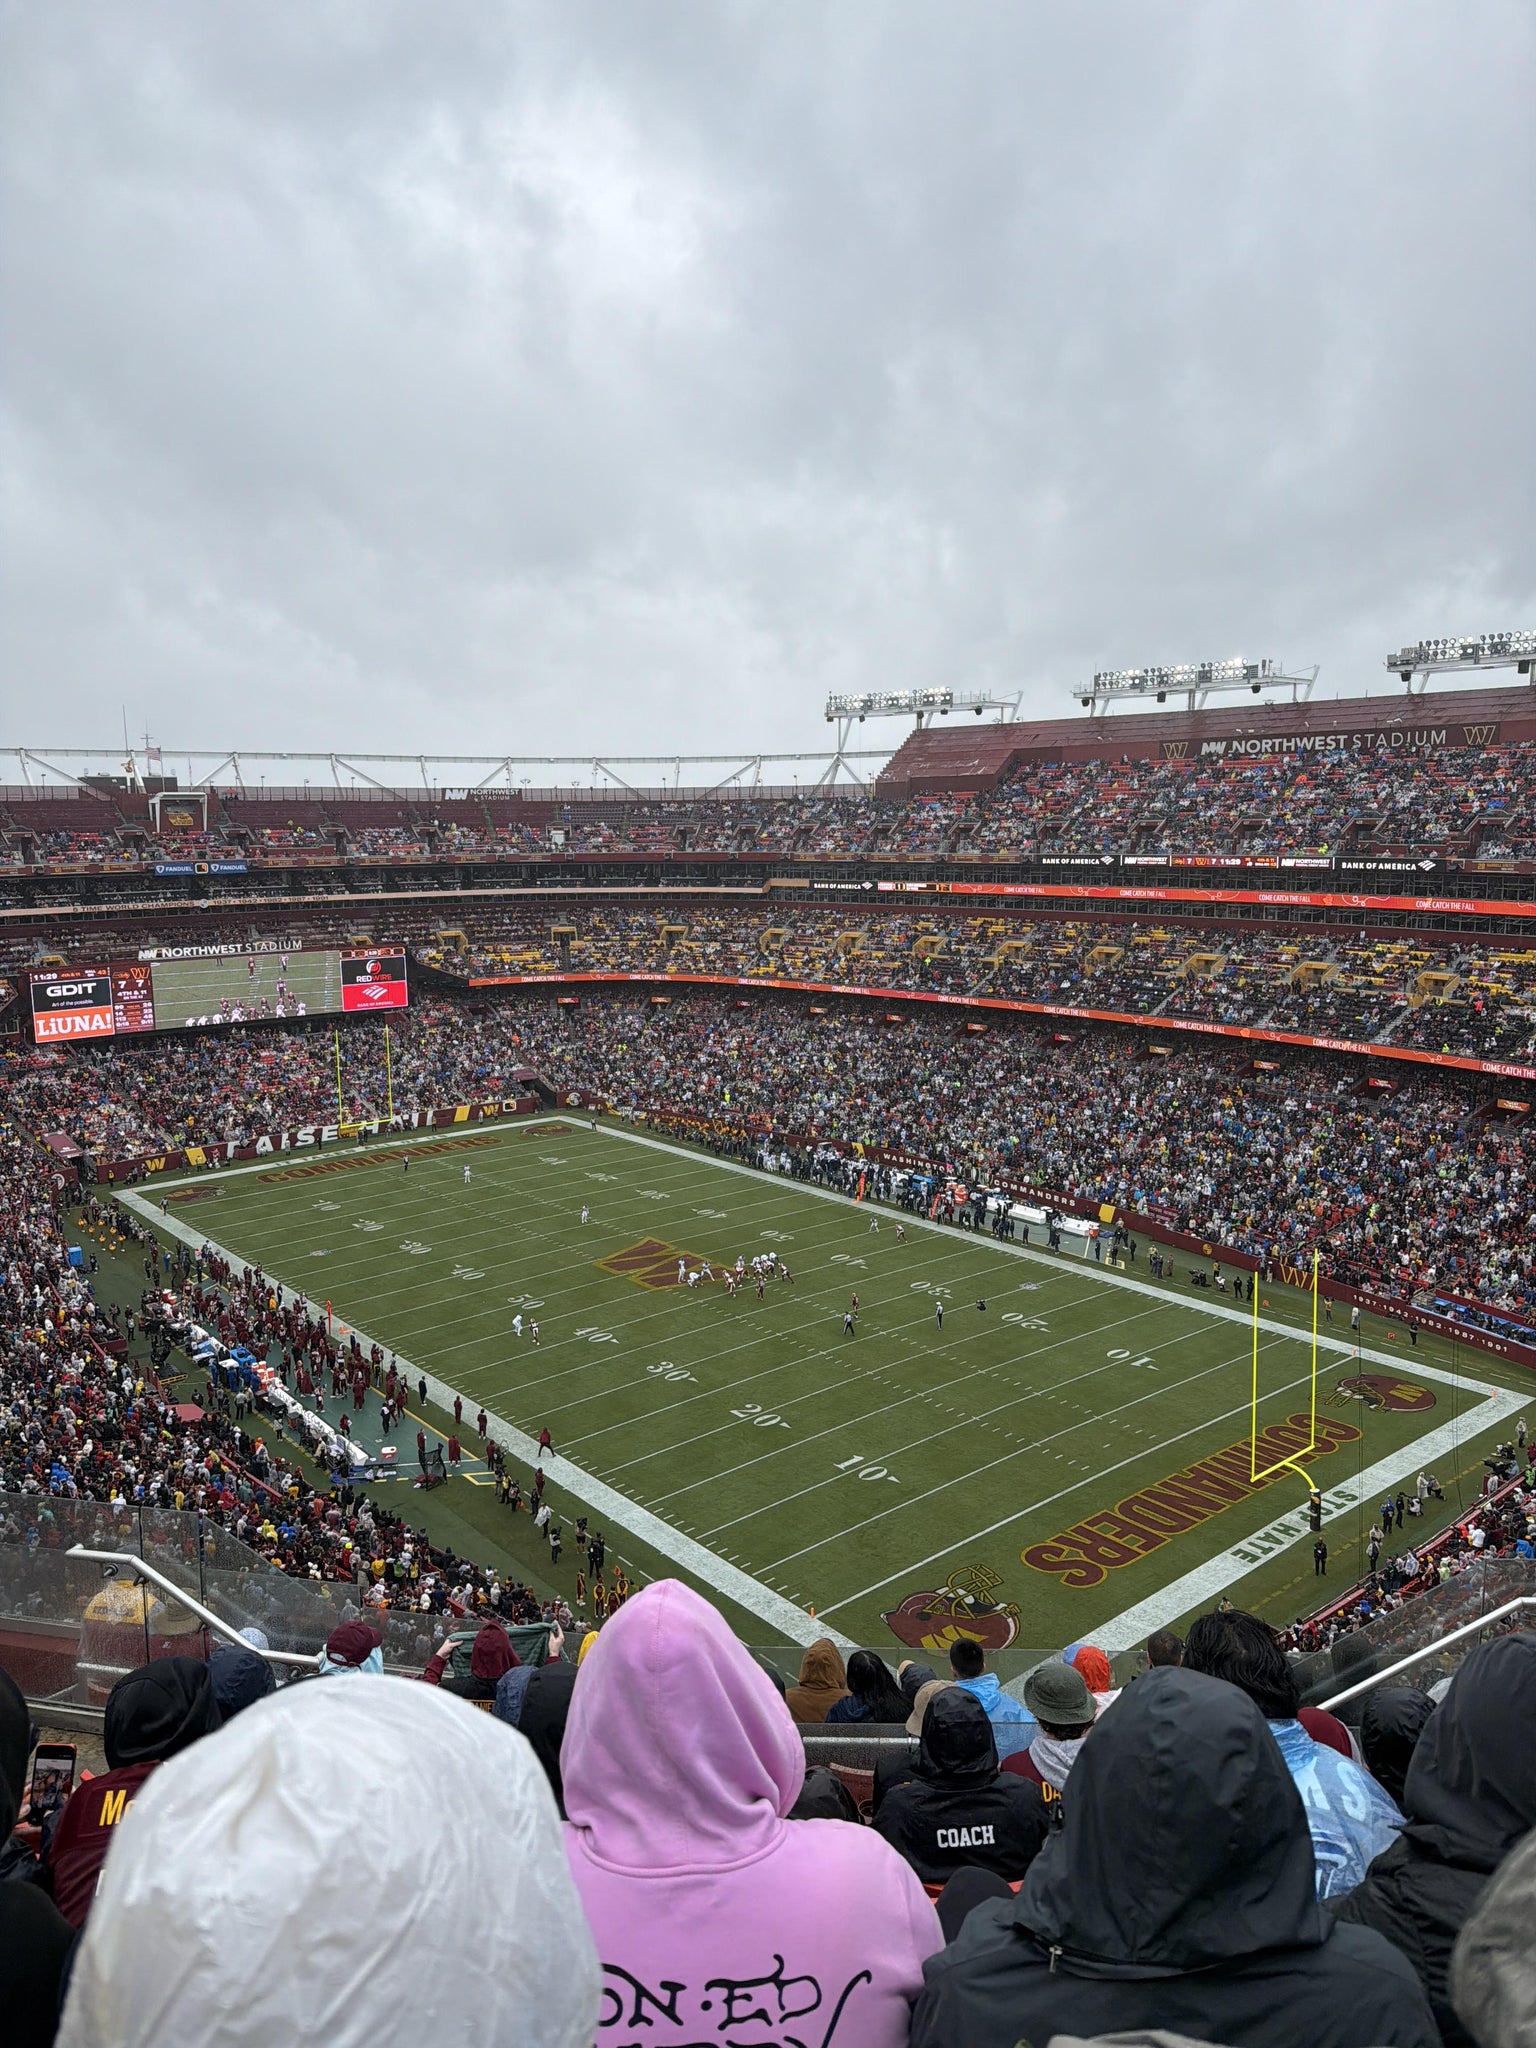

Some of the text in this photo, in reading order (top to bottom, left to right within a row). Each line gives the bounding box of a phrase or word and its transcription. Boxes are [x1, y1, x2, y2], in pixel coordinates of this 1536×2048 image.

[1230, 735, 1348, 754] NORTHWEST
[1352, 730, 1446, 749] STADIUM
[1450, 902, 1461, 910] THE
[162, 943, 243, 958] NORTHWEST
[245, 940, 302, 953] STADIUM
[46, 982, 97, 997] GDIT
[118, 981, 126, 989] 7
[1057, 1007, 1070, 1015] CATCH
[36, 1012, 112, 1036] LiUNA!
[1173, 1021, 1225, 1034] COME CATCH THE FALL
[1313, 1038, 1328, 1047] COME
[1347, 1042, 1358, 1051] THE
[1359, 1044, 1371, 1053] FALL
[1482, 1062, 1536, 1079] COME CATCH THE
[256, 1135, 504, 1185] COMMANDERS
[883, 1153, 1076, 1207] WASHINGTO COMMANDERS
[759, 1230, 795, 1242] 50
[400, 1242, 432, 1254] 30
[830, 1254, 866, 1266] 40
[451, 1267, 486, 1280] 40
[910, 1281, 951, 1297] 30
[507, 1293, 546, 1310] 50
[1001, 1312, 1049, 1329] 20
[1353, 1294, 1508, 1352] 1937 1942 1982 1987 1991
[573, 1326, 613, 1343] 40
[1106, 1348, 1156, 1368] 10
[646, 1361, 691, 1382] 30
[729, 1403, 782, 1428] 20
[833, 1454, 888, 1481] 10
[1020, 1412, 1363, 1588] COMMANDERS
[1230, 1522, 1302, 1564] HATE
[937, 1825, 995, 1849] COACH
